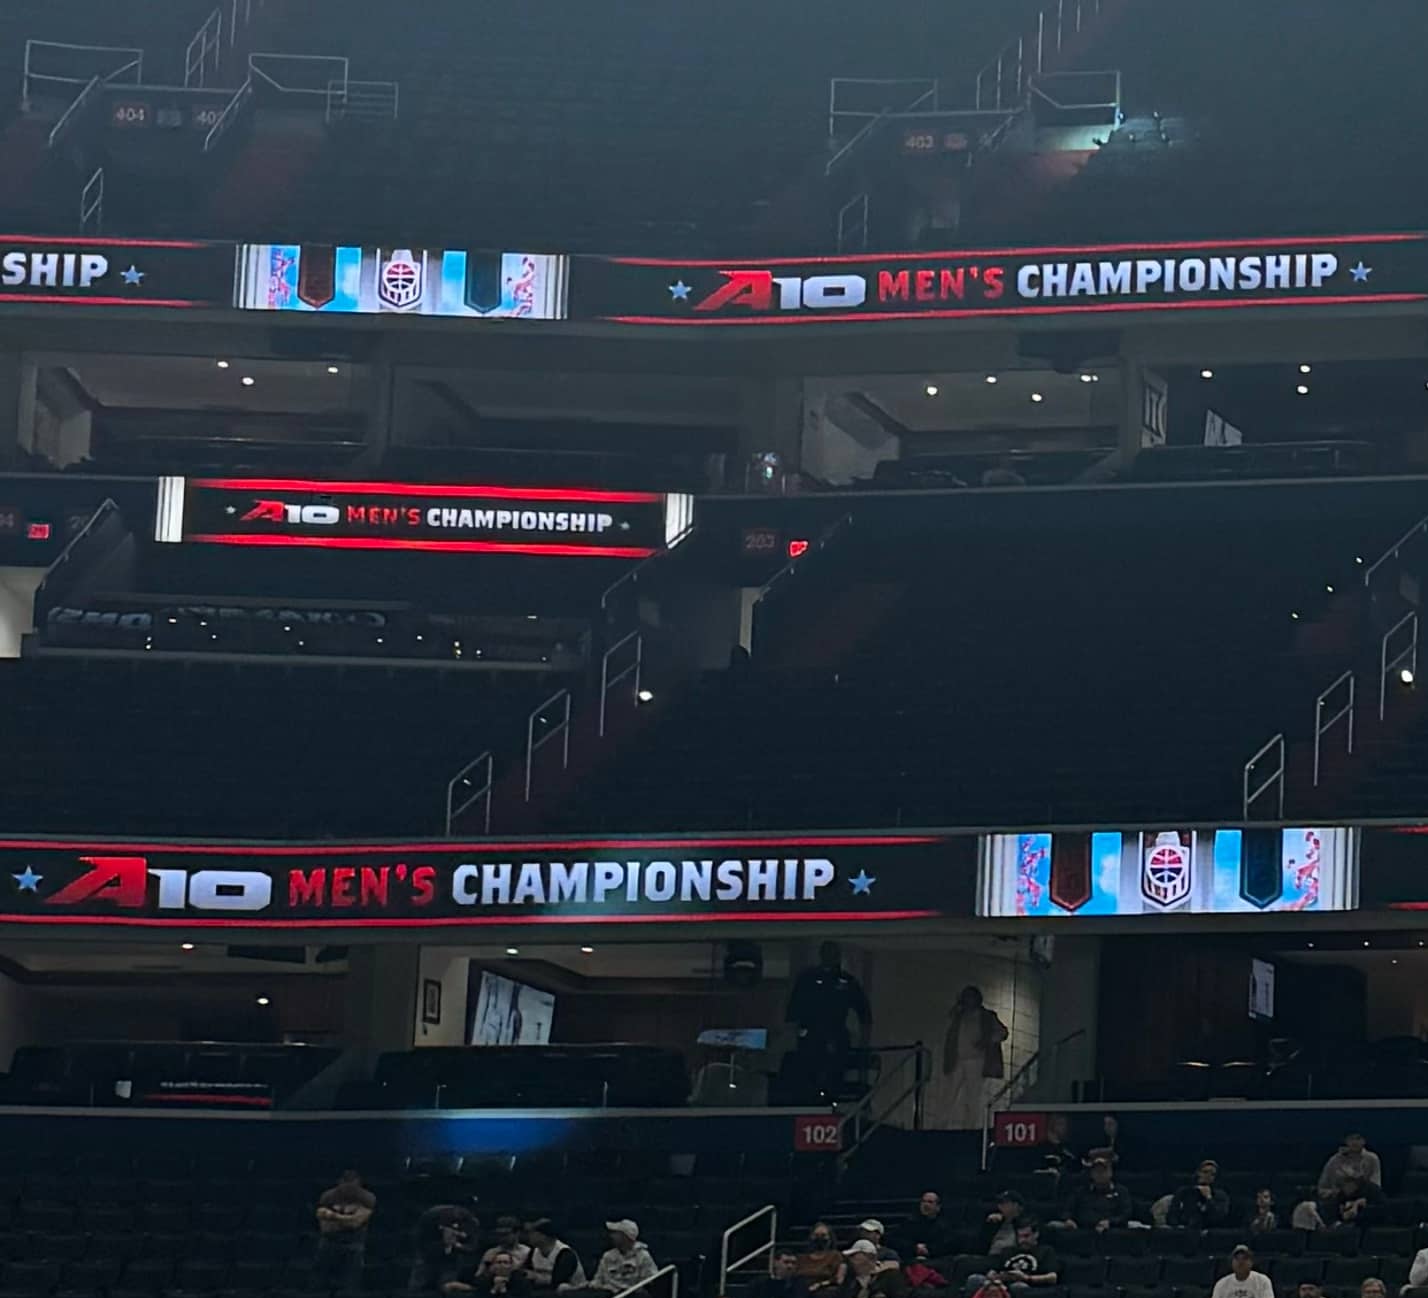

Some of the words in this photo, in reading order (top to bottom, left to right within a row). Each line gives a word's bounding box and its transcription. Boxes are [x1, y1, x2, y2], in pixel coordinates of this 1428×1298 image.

[3, 253, 109, 288] SHIP
[694, 269, 866, 310] A10
[880, 268, 1004, 301] MEN'S
[1019, 255, 1338, 298] CHAMPIONSHIP
[240, 501, 339, 526] A10
[349, 507, 421, 526] MEN'S
[428, 509, 613, 533] CHAMPIONSHIP
[45, 856, 272, 910] A10
[291, 865, 436, 906] MEN'S
[454, 860, 835, 905] CHAMPIONSHIP
[803, 1124, 837, 1144] 102
[1005, 1122, 1036, 1142] 101
